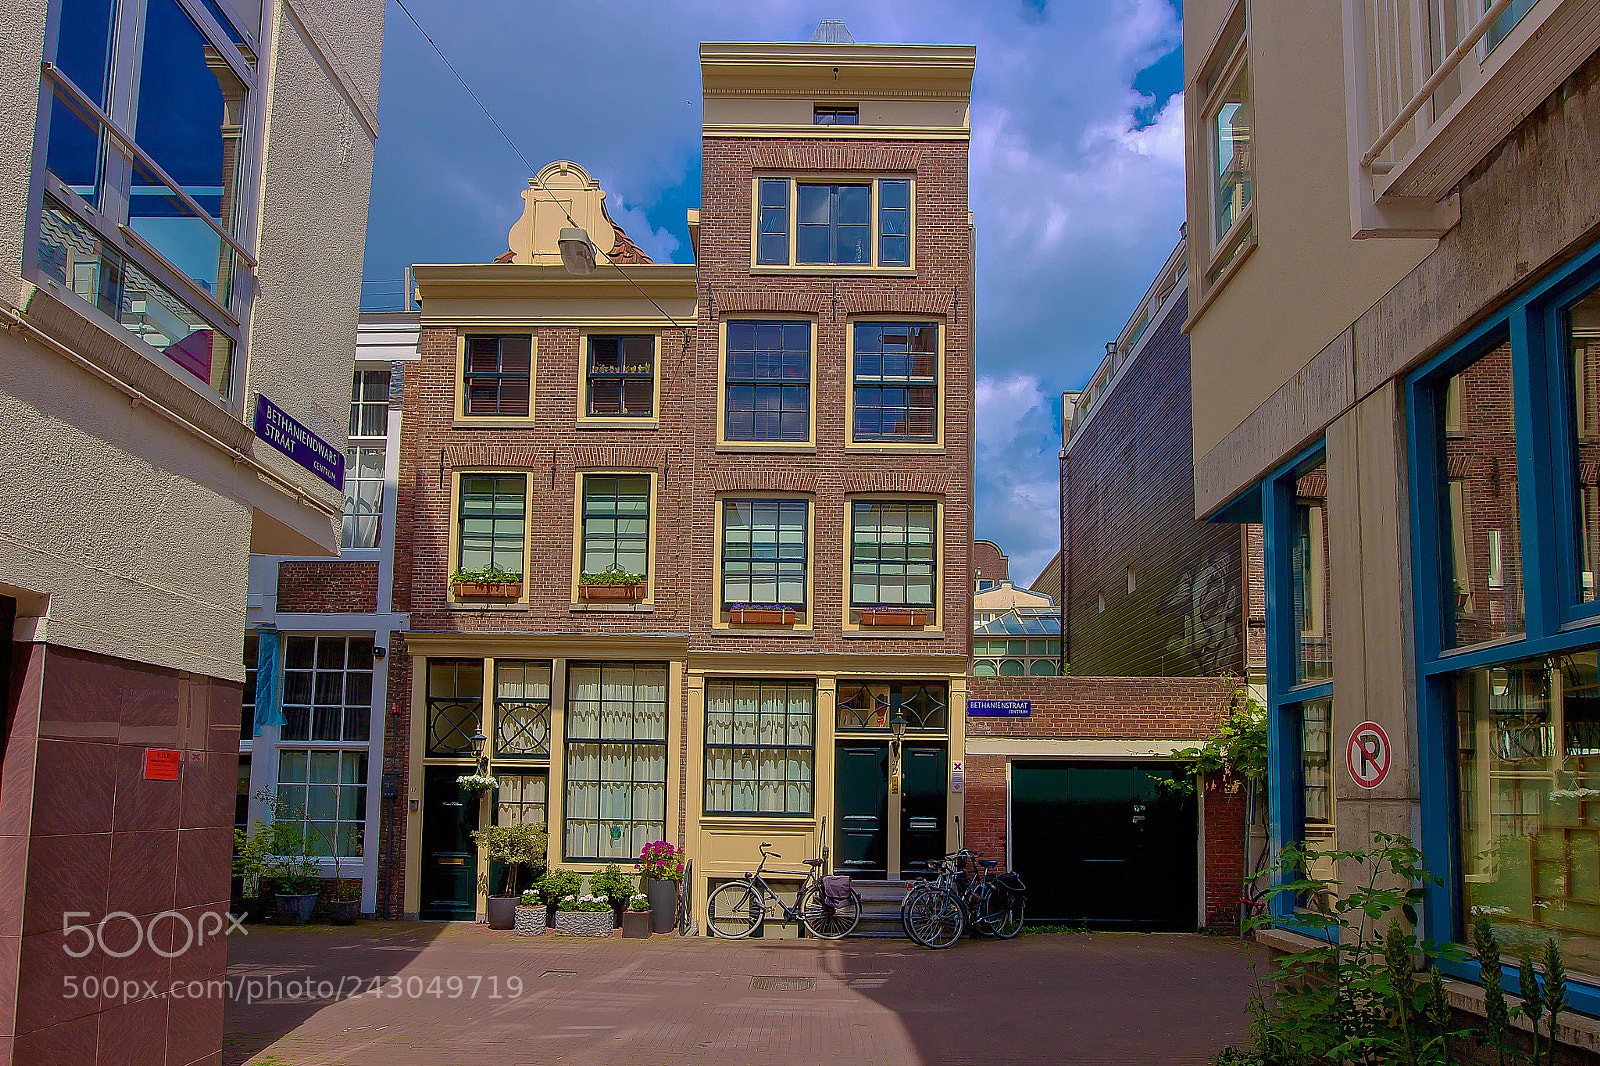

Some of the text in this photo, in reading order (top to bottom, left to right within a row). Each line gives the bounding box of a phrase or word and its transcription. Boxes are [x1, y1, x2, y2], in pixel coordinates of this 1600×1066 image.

[264, 423, 296, 453] STRAAT
[266, 405, 337, 466] BETHANIENDWARS
[313, 460, 336, 481] CENTRUM
[970, 701, 1028, 709] BETHANIENSTRAAT
[1360, 735, 1380, 776] P
